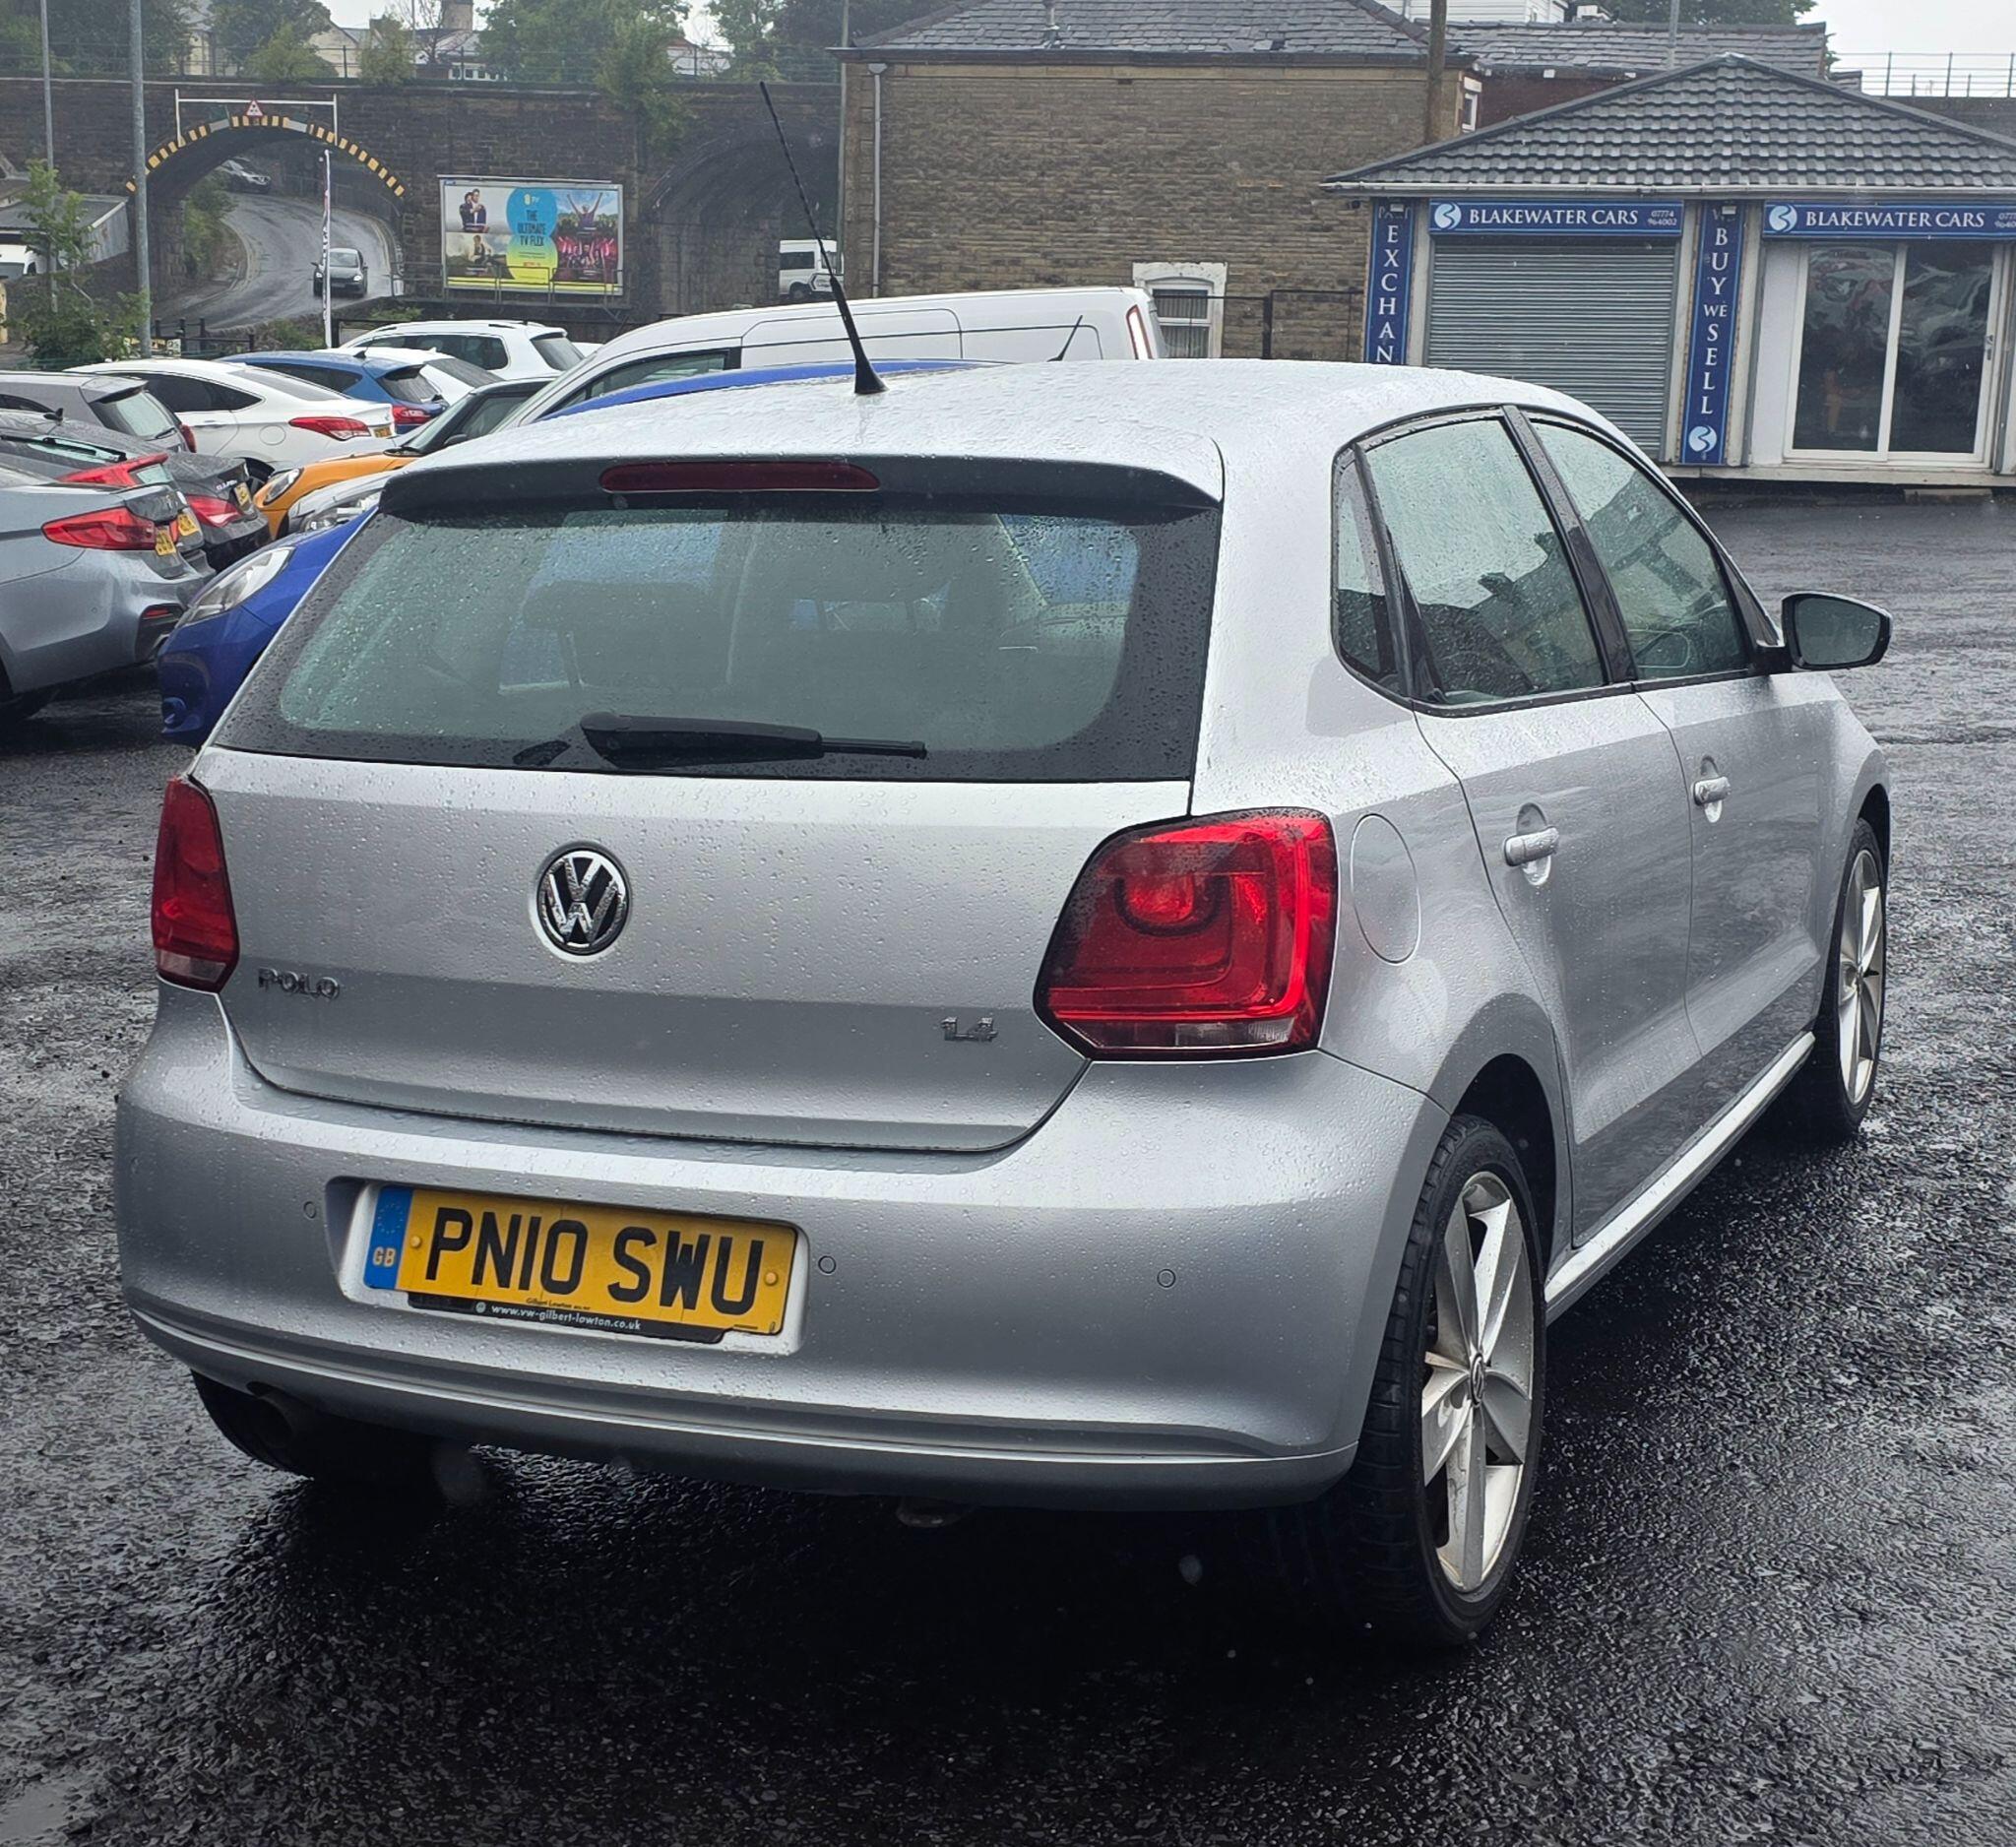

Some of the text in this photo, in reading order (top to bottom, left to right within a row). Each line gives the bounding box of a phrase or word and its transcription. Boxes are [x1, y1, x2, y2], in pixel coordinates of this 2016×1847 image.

[1469, 209, 1638, 224] BLAKEWATER CARS
[1805, 212, 1985, 227] BLAKEWATER CARS
[1701, 227, 1729, 414] BUY WE SELL
[258, 967, 341, 1000] POLO
[373, 1246, 396, 1267] GB
[606, 1225, 764, 1316] SWU
[491, 1305, 642, 1331] www.vw-gilbert-lowton.co.uk
